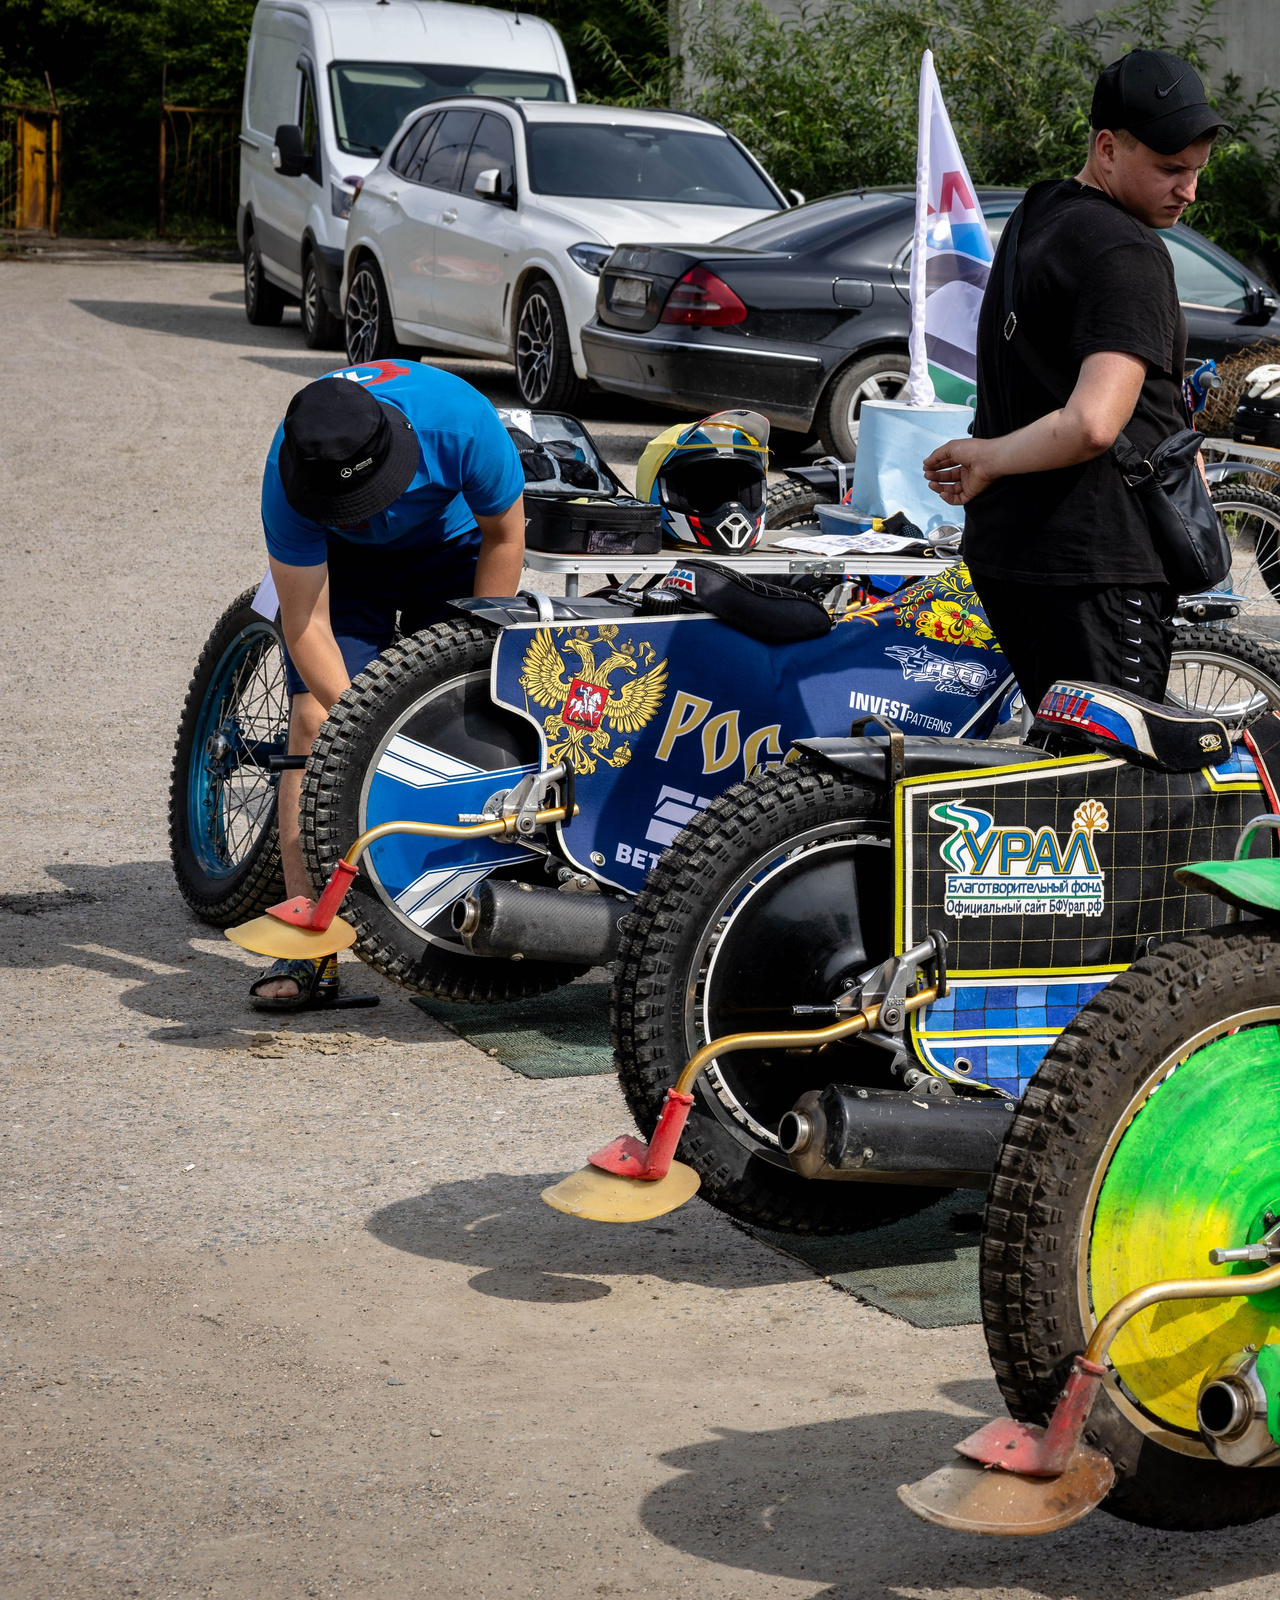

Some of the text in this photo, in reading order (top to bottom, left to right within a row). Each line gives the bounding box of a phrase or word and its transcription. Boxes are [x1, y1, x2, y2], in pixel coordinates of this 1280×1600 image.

[906, 655, 988, 688] SPEED
[960, 829, 1099, 876] УРАЛ
[947, 878, 1102, 896] Благотворительный фонд
[946, 899, 1022, 916] Официальный
[1024, 899, 1047, 913] сайт
